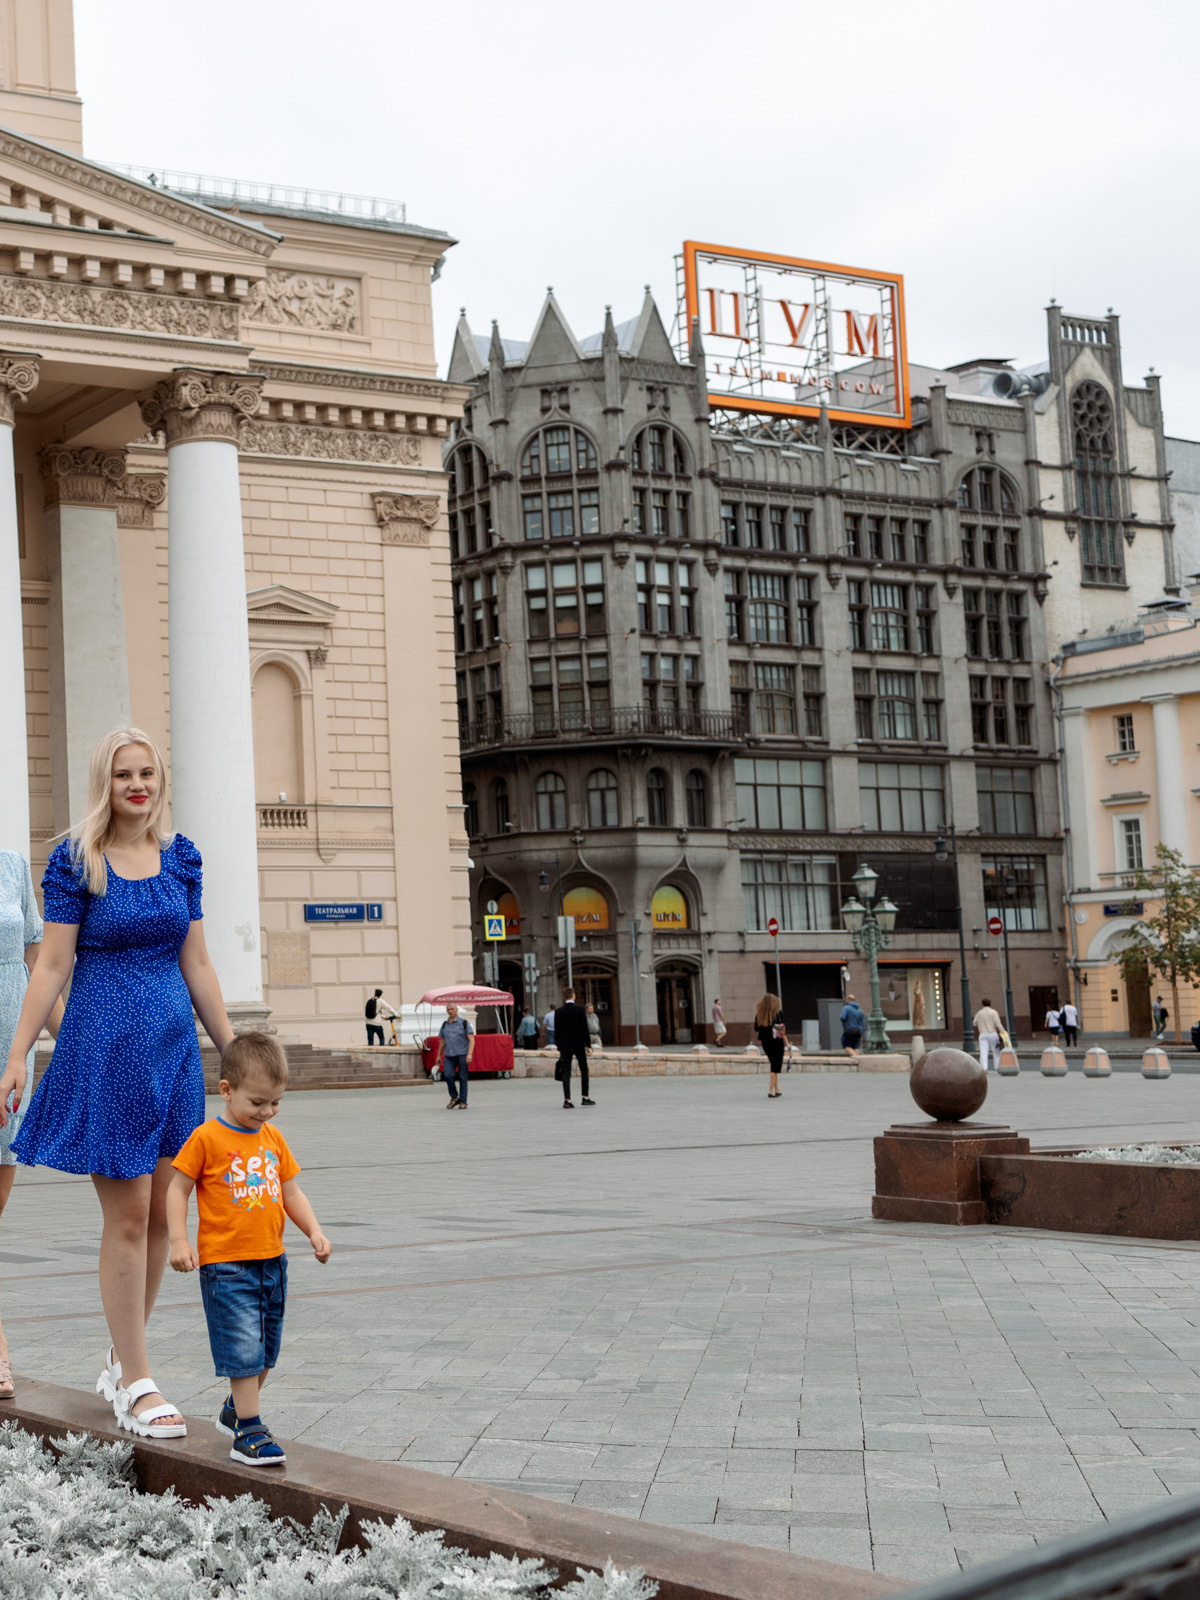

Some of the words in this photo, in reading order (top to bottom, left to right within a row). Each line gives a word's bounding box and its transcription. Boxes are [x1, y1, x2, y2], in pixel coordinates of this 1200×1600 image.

[704, 287, 889, 360] ЦУМ
[714, 363, 773, 381] TSUM
[790, 373, 884, 395] MOSCOW
[373, 906, 378, 918] 1
[233, 1179, 279, 1199] world
